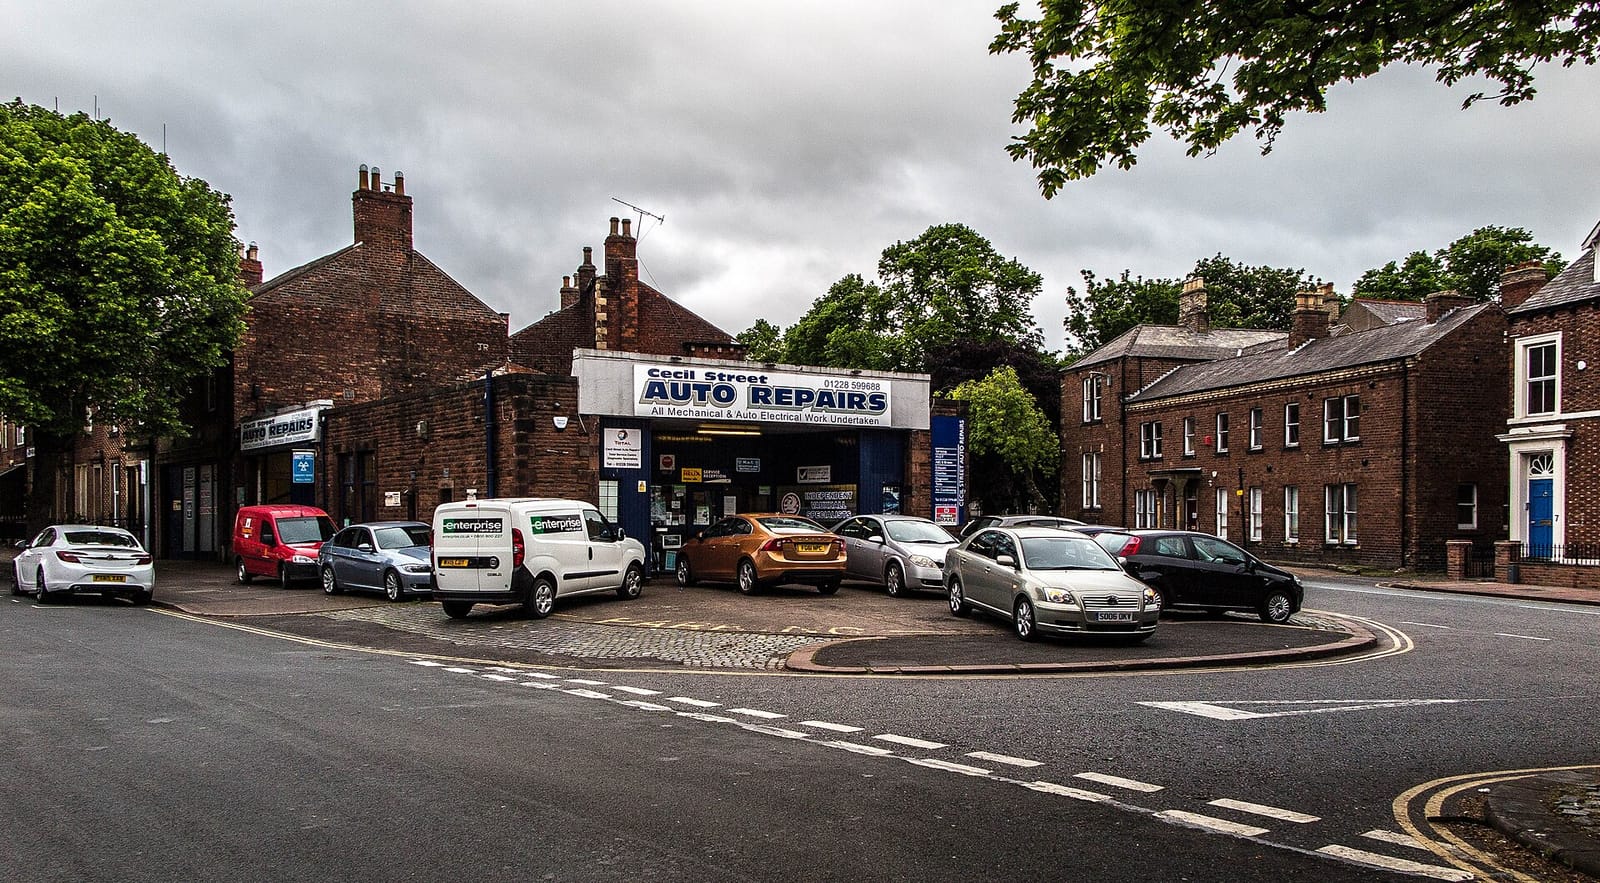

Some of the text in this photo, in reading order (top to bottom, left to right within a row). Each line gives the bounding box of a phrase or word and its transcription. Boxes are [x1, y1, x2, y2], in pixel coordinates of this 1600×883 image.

[647, 368, 768, 384] Cecil Street
[823, 379, 881, 391] 01228 599688
[640, 380, 888, 414] AUTO REPAIRS
[651, 406, 880, 425] All Mechanical & Auto Electrical Work Undertaken
[242, 417, 314, 441] AUTO REPAIRS
[804, 491, 853, 500] INDEPENDENT
[806, 510, 852, 519] SPECIALISTS
[1554, 514, 1560, 522] 7
[446, 520, 502, 532] enterprise
[534, 518, 582, 530] enterprise
